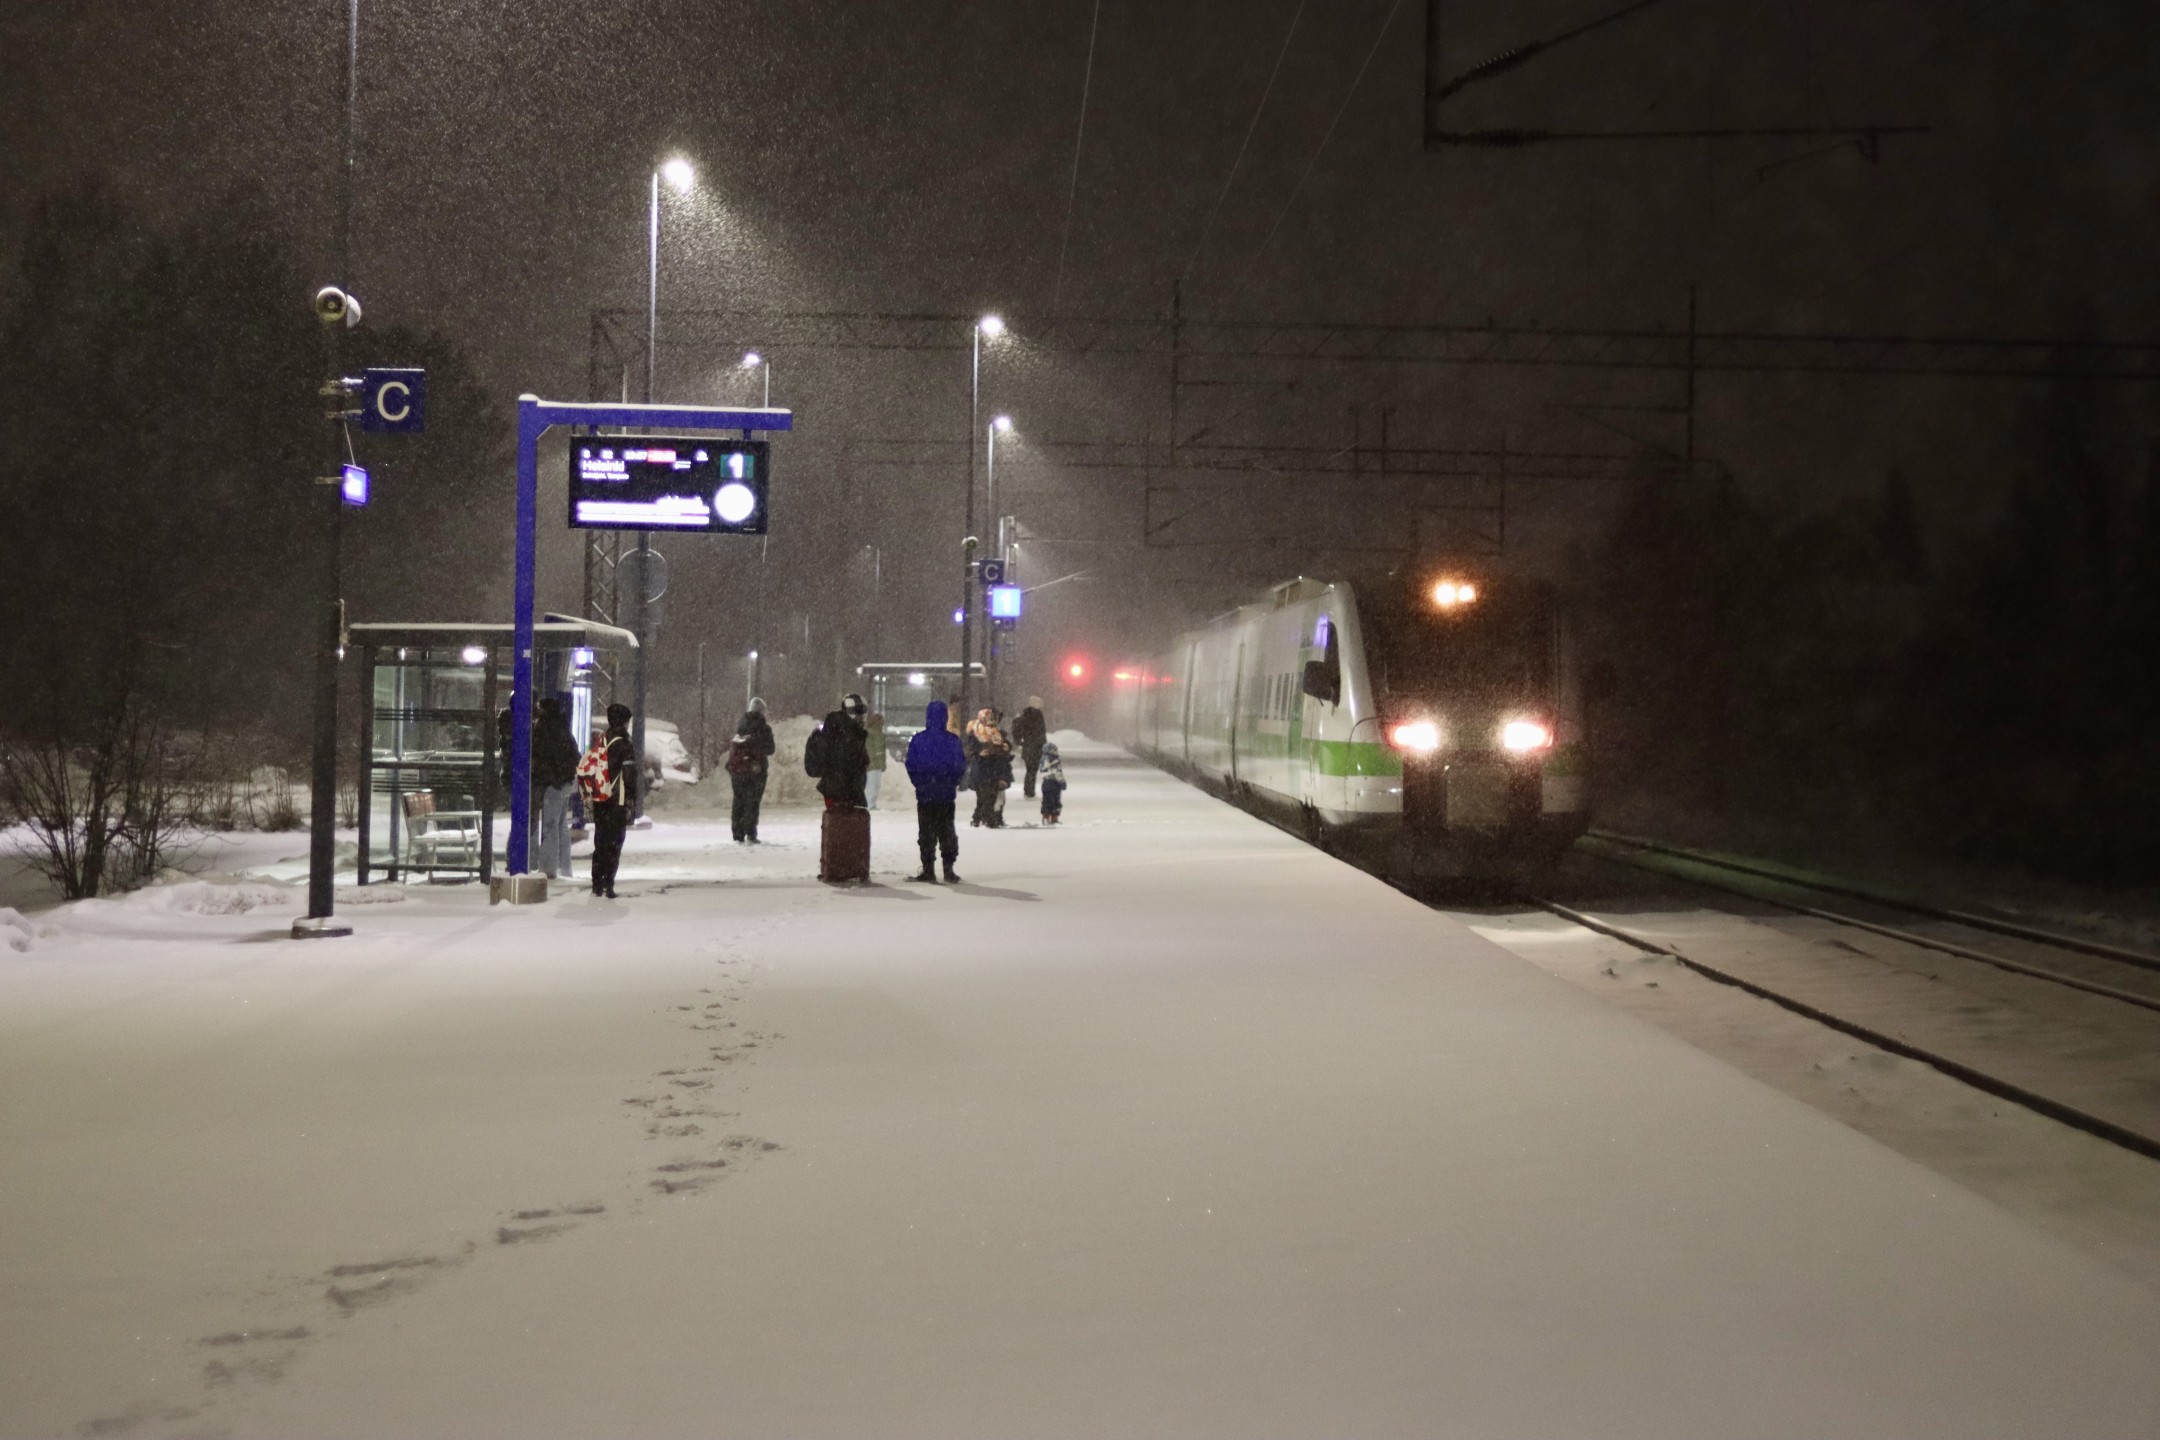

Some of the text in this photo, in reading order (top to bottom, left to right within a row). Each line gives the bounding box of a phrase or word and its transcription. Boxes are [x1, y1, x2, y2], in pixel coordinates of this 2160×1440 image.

[377, 381, 410, 421] C
[728, 453, 744, 479] 1
[985, 564, 999, 580] C
[1000, 592, 1011, 613] 1
